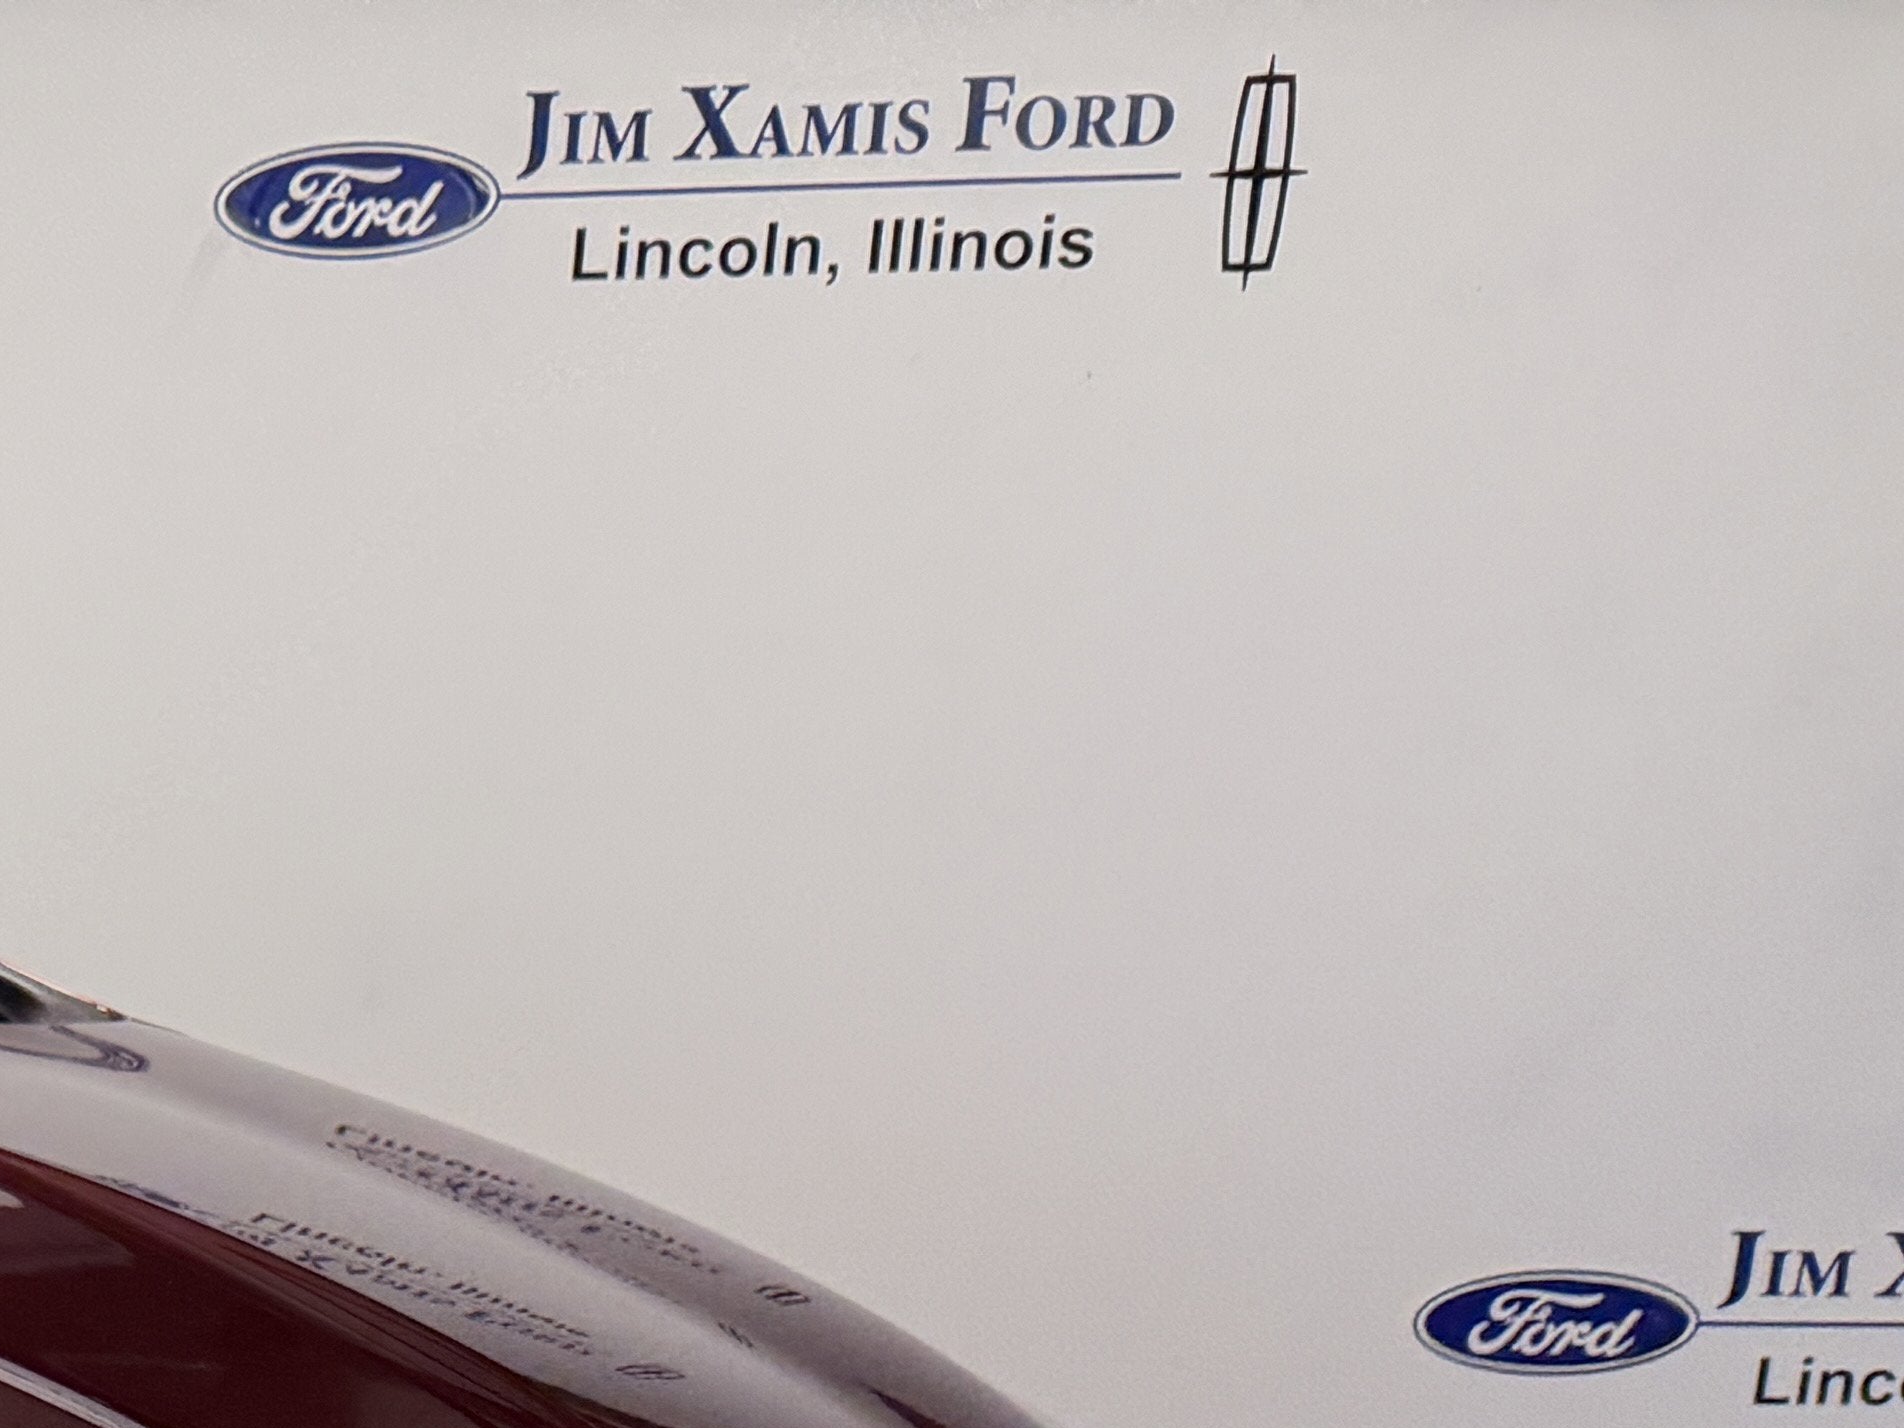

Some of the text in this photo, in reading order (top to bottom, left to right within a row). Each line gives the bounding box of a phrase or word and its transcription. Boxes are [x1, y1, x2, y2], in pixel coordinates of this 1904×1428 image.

[515, 73, 1176, 180] JIM XAMIS FORD
[270, 160, 438, 240] Ford
[572, 213, 1095, 286] Lincoln, Illinois
[1715, 1229, 1857, 1310] JIM
[1467, 1286, 1644, 1358] Ford
[1752, 1355, 1904, 1406] Linc
